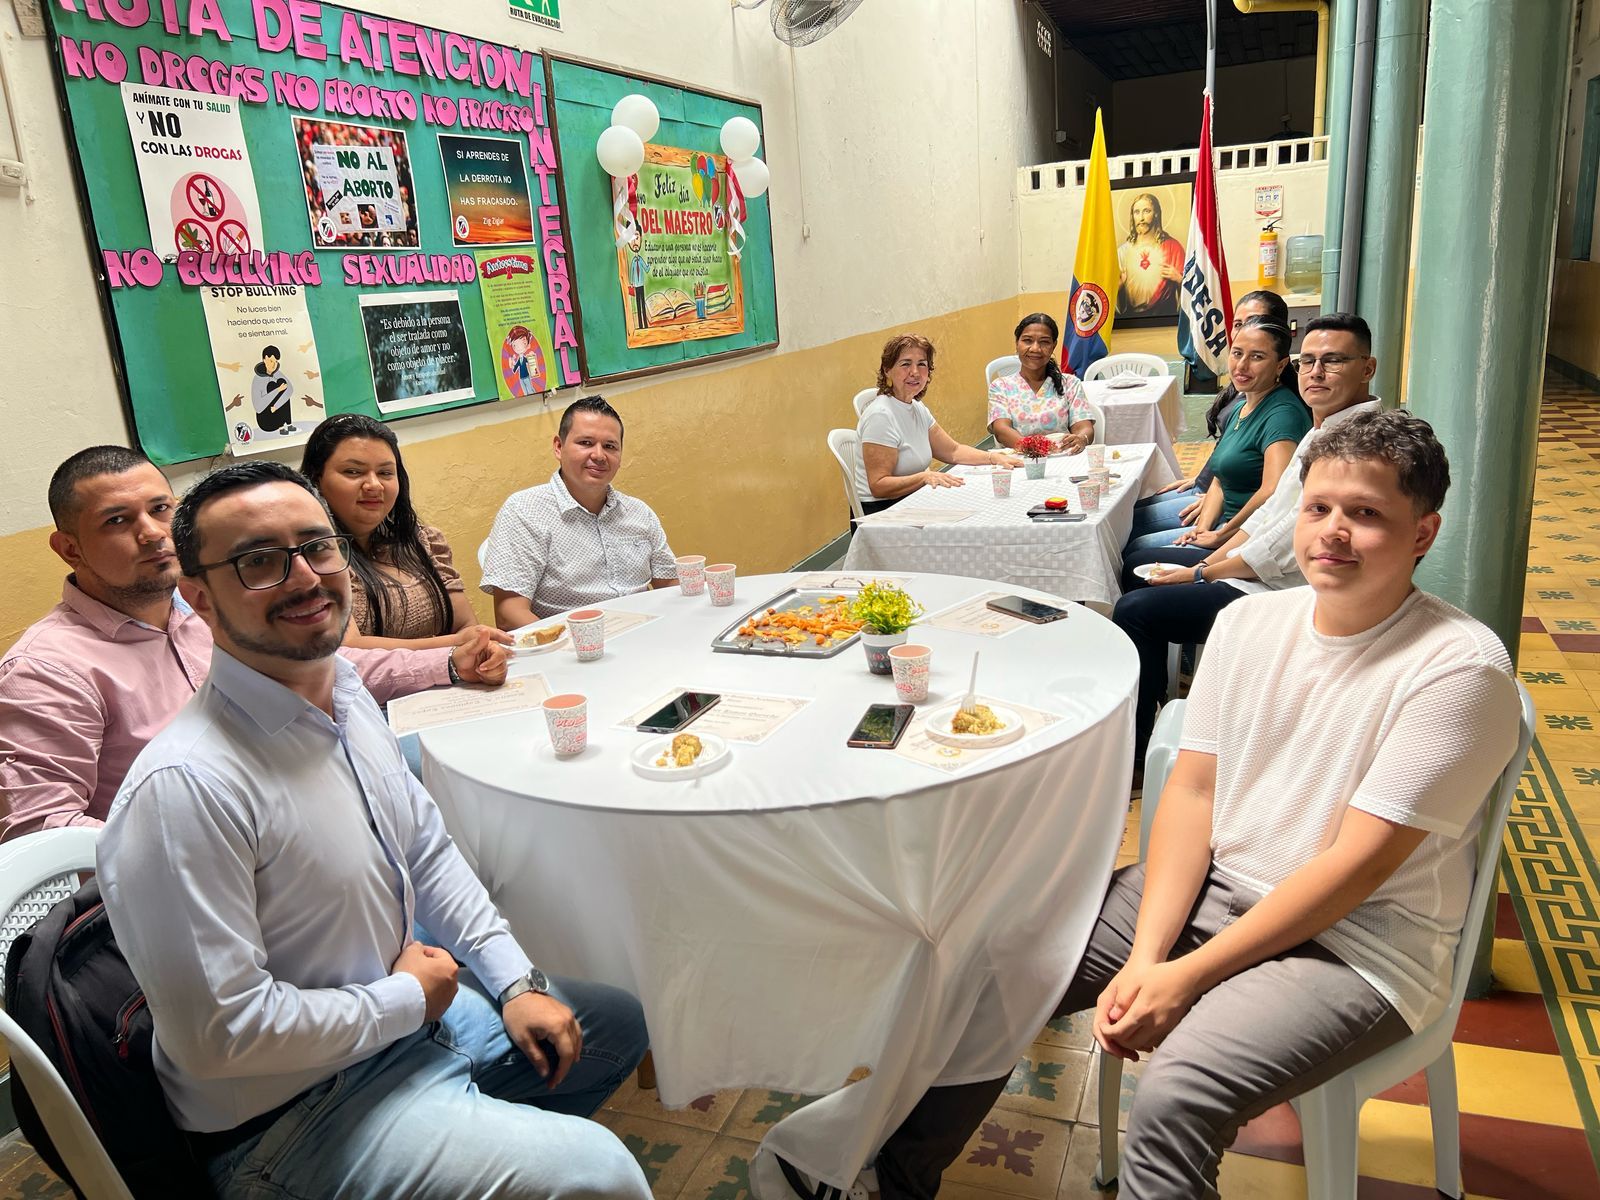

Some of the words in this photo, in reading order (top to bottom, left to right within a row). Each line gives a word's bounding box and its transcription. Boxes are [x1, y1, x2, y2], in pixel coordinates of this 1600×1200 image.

[510, 7, 524, 18] RUTA
[524, 11, 531, 20] DE
[251, 0, 327, 61] DE
[340, 12, 532, 97] ATENCION
[59, 35, 128, 84] NO
[139, 46, 269, 103] DROGAS
[272, 71, 319, 111] NO
[325, 78, 417, 120] ABORTO
[422, 93, 458, 127] NO
[458, 98, 534, 133] FRACASO
[133, 91, 170, 106] ANÍMATE
[173, 98, 190, 108] CON
[193, 100, 203, 110] TU
[206, 102, 231, 113] SALUD
[136, 111, 144, 124] Y
[148, 110, 182, 138] NO
[141, 141, 168, 154] CON
[171, 144, 192, 156] LAS
[194, 146, 242, 160] DROGAS
[456, 150, 464, 159] SI
[466, 151, 500, 161] APRENDES
[501, 153, 509, 162] DE
[336, 151, 360, 169] NO
[368, 152, 388, 170] AL
[459, 174, 469, 182] LA
[471, 174, 502, 183] DERROTA
[503, 176, 512, 184] NO
[654, 171, 676, 199] Feliz
[343, 178, 393, 199] ABORTO
[460, 197, 475, 206] HAS
[477, 197, 518, 206] FRACASADO.
[641, 207, 662, 234] DEL
[664, 210, 713, 236] MAESTRO
[529, 82, 581, 385] INTEGRAL
[102, 248, 163, 288] NO
[177, 250, 322, 287] BULLYING
[342, 252, 477, 286] SEXUALIDAD
[211, 287, 243, 298] STOP
[245, 286, 297, 297] BULLYING
[248, 305, 267, 313] luces
[227, 318, 261, 326] haciendo
[262, 318, 275, 326] que
[392, 316, 416, 328] debido
[421, 315, 427, 326] la
[427, 315, 451, 328] persona
[247, 330, 275, 338] sientan
[389, 331, 396, 343] el
[397, 333, 407, 342] ser
[407, 329, 431, 341] tratada
[431, 329, 448, 339] como
[390, 346, 411, 358] objeto
[411, 343, 420, 354] de
[420, 343, 436, 353] amor
[436, 343, 441, 353] y
[442, 342, 451, 351] no
[387, 361, 405, 372] como
[405, 357, 426, 370] objeto
[426, 355, 435, 366] de
